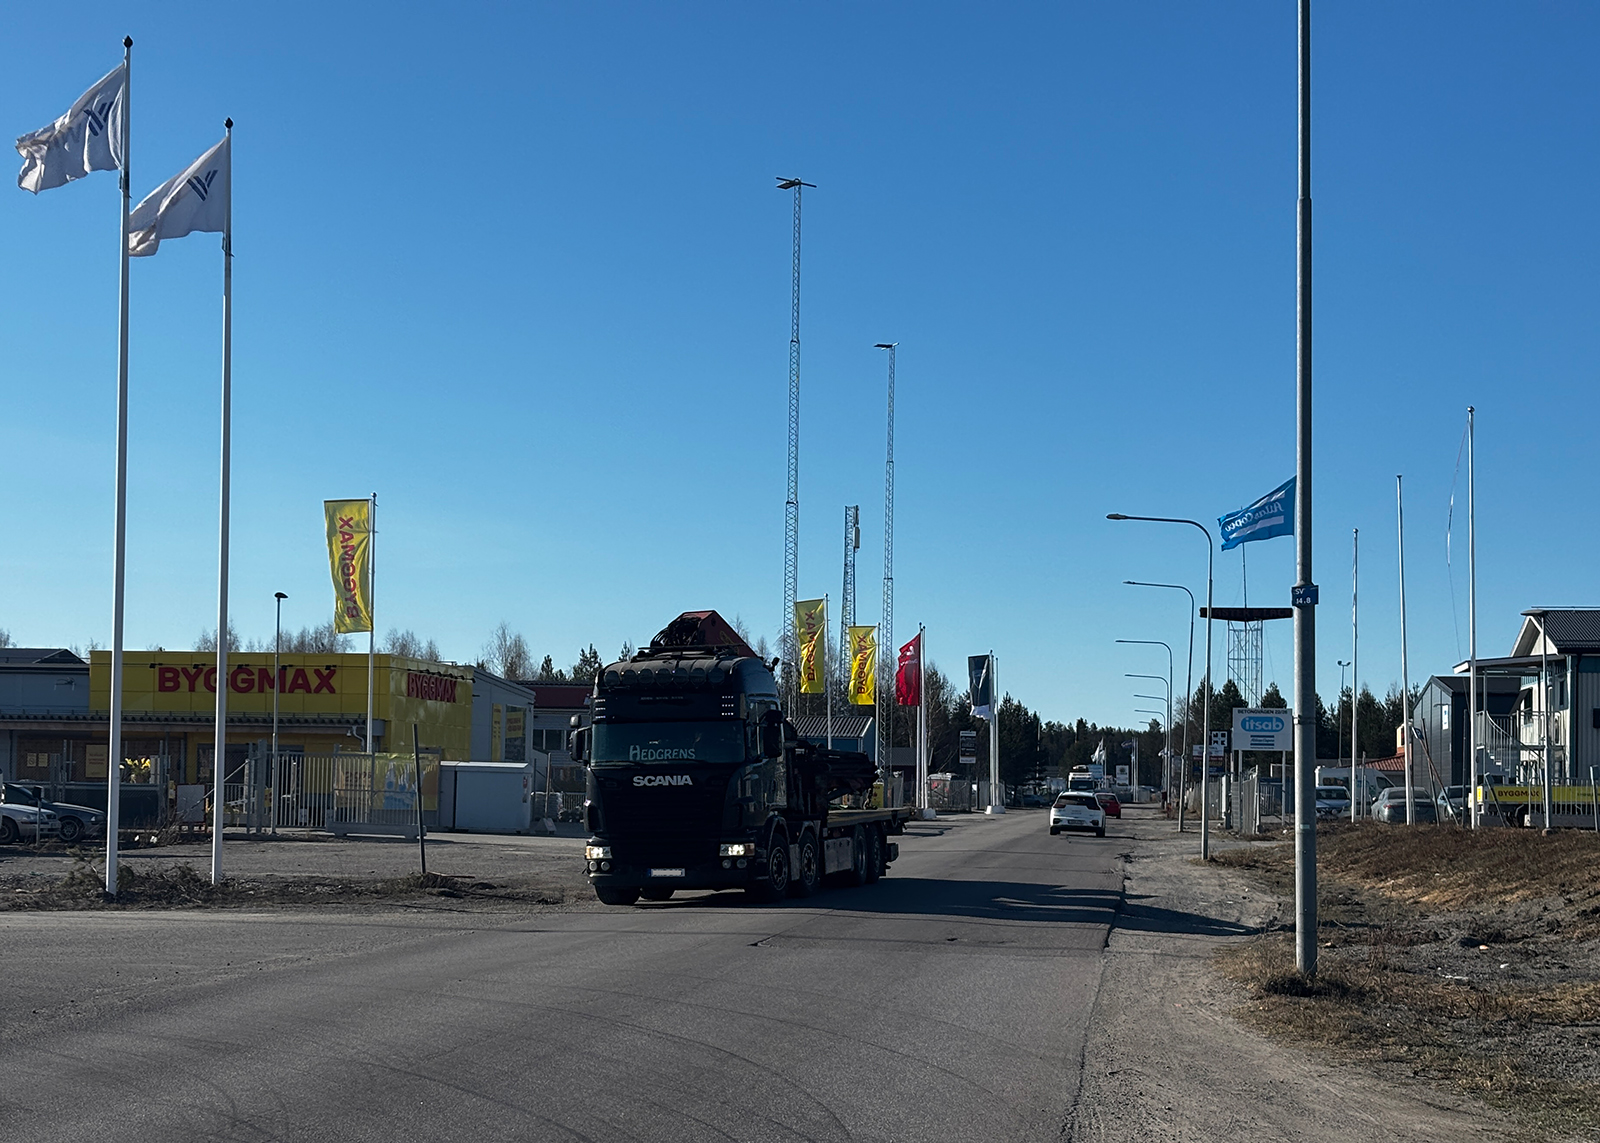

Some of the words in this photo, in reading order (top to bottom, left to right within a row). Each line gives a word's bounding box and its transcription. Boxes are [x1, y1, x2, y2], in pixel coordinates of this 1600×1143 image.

[158, 667, 337, 694] BYGGMAX
[407, 672, 458, 703] BYGGMAX
[1245, 717, 1283, 731] itsab
[632, 775, 693, 787] SCANIA
[1497, 790, 1540, 798] BYGGMAX
